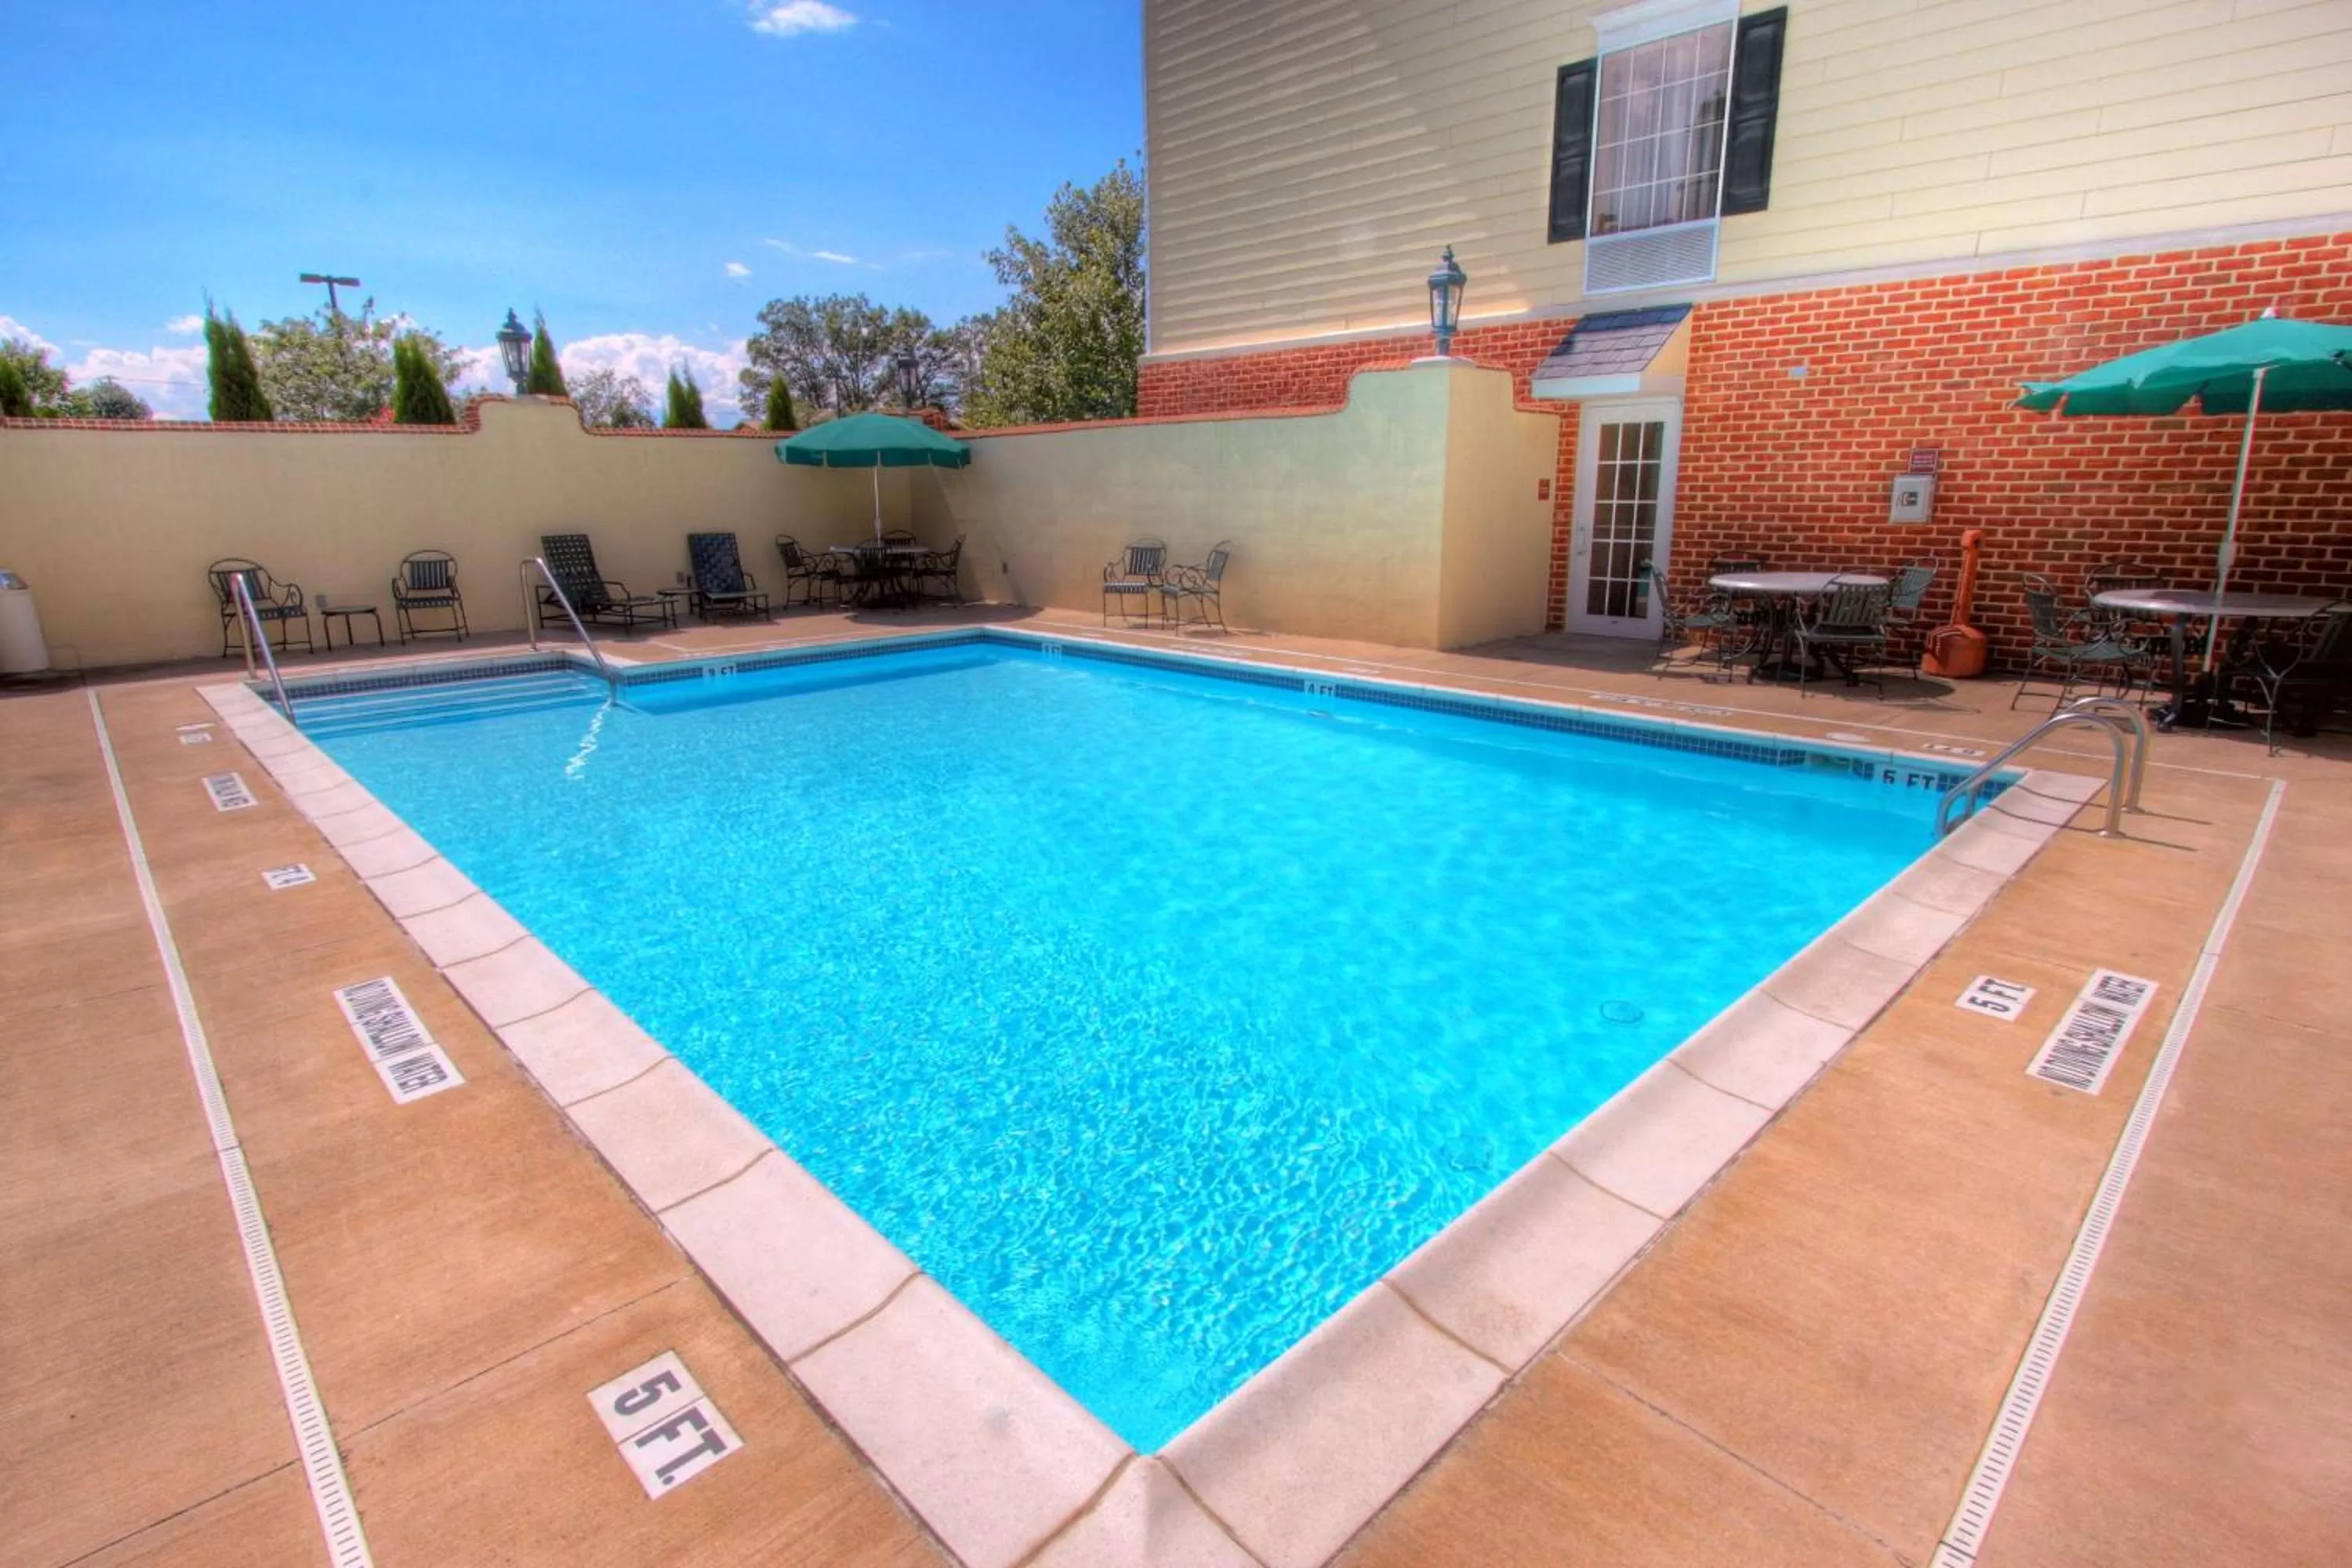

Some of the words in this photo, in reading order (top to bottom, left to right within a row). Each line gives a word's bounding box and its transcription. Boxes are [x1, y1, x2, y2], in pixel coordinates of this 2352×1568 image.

[1882, 769, 1896, 785] 5
[1906, 772, 1936, 791] FT
[1966, 995, 2011, 1013] 5
[614, 1370, 682, 1417] 5
